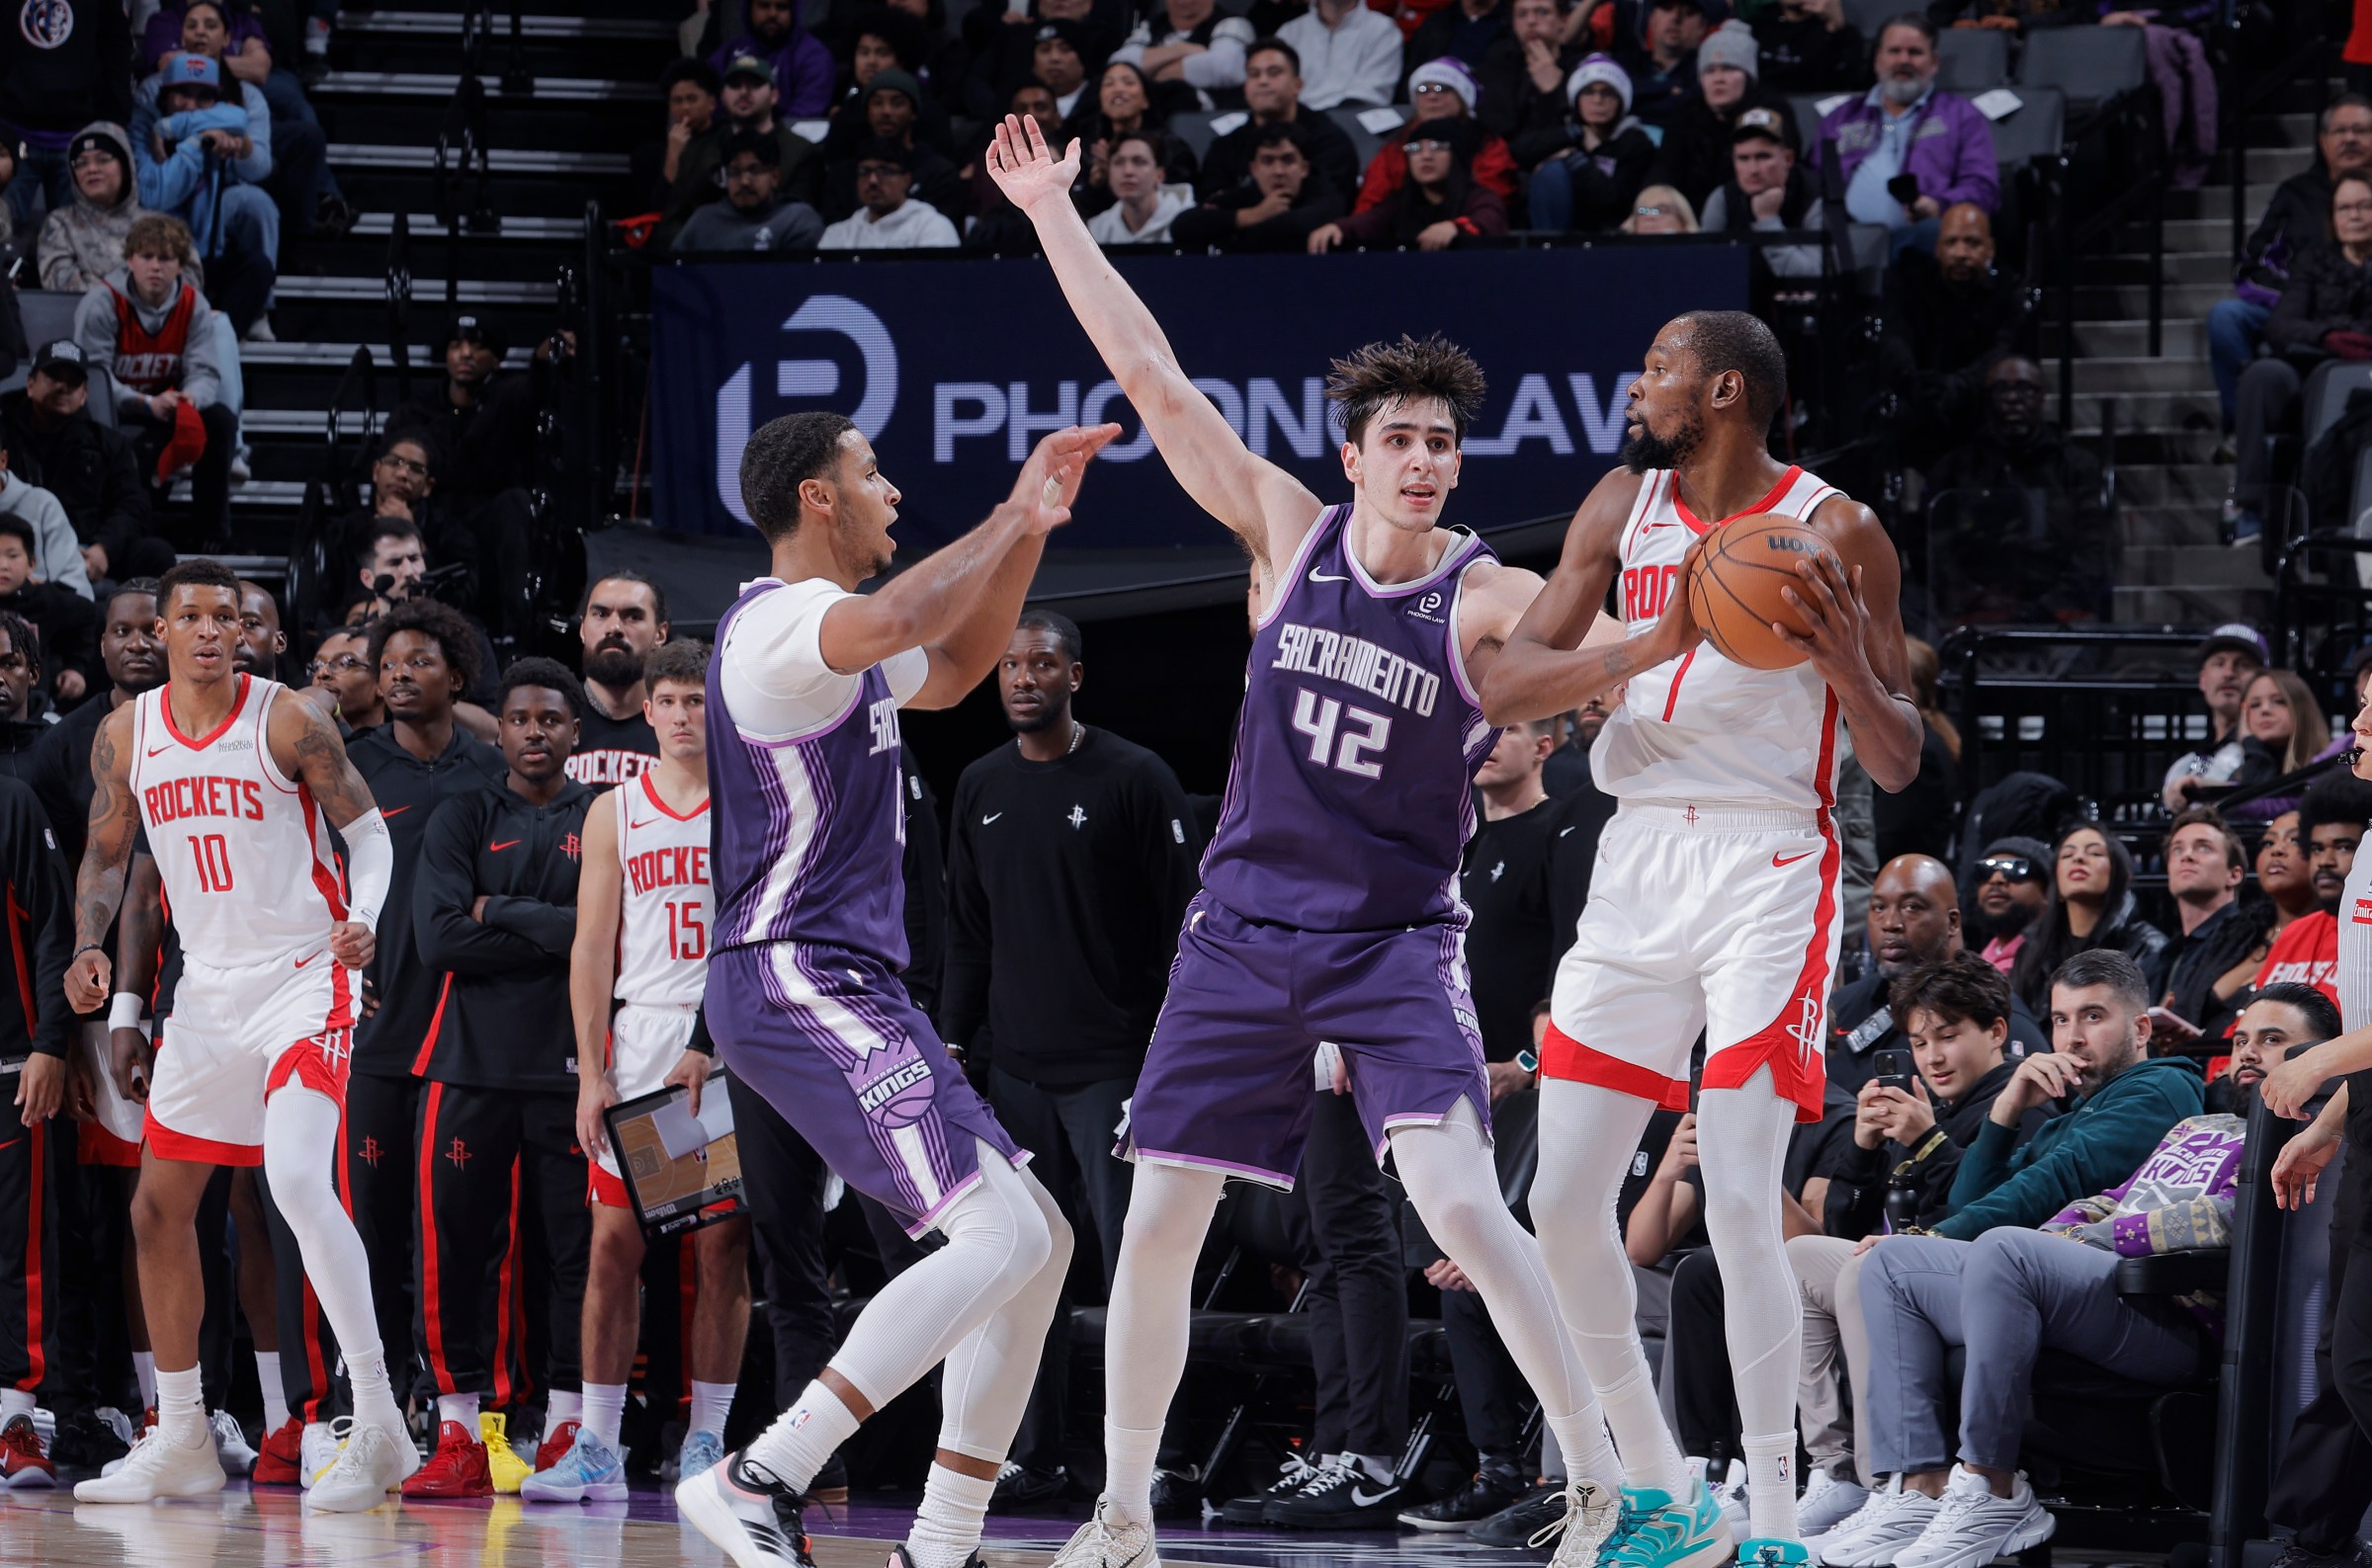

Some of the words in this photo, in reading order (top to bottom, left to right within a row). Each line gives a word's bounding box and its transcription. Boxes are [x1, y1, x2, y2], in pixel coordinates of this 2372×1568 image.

[1458, 371, 1644, 455] AW
[1407, 610, 1431, 620] PHOONG
[1271, 622, 1440, 718] SACRAMENTO
[1292, 687, 1393, 781] 42
[144, 776, 264, 828] ROCKETS
[188, 834, 234, 893] 10
[665, 901, 705, 960] 15
[856, 1053, 920, 1095] SACRAMENTO
[858, 1059, 932, 1114] KINGS
[644, 1202, 677, 1219] Wilson
